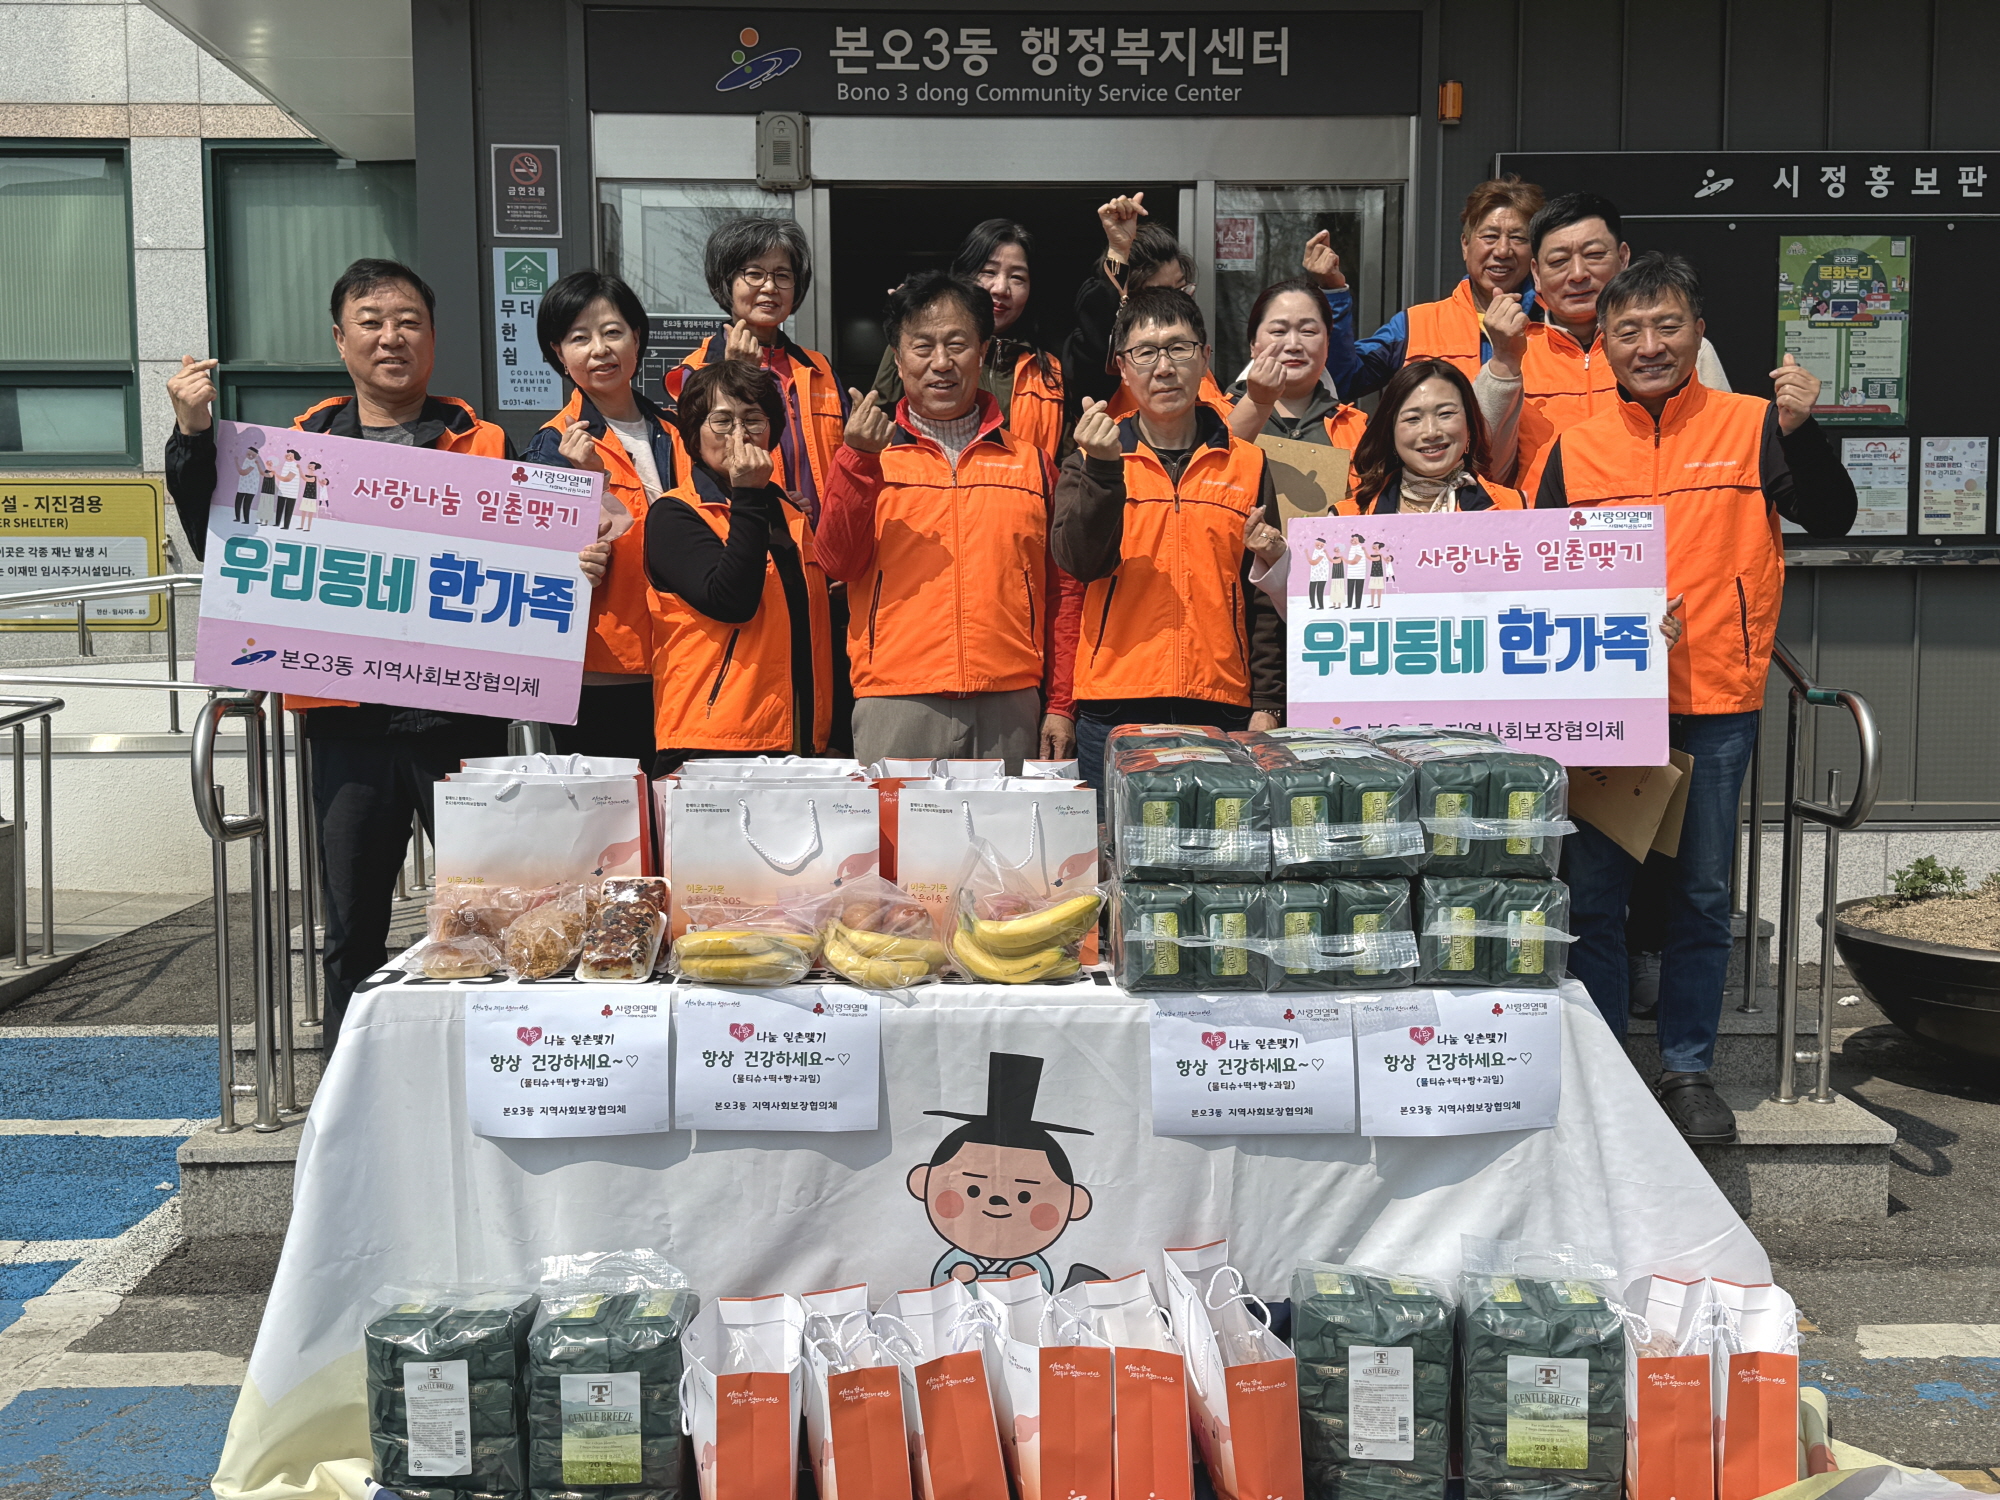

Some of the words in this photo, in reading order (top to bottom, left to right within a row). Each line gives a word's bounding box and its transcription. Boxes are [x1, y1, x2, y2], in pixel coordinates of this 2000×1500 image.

[829, 26, 998, 77] 본오3동
[1020, 27, 1289, 77] 행정복지센터
[837, 83, 890, 101] Bono
[896, 83, 908, 101] 3
[916, 82, 969, 106] dong
[975, 83, 1093, 106] Community
[1098, 84, 1168, 102] Service
[1174, 84, 1242, 102] Center
[1773, 164, 1988, 199] 시정홍보판
[1834, 256, 1858, 264] 2025
[1819, 265, 1872, 279] 문화누리
[1832, 280, 1860, 294] 카드
[500, 300, 535, 318] 무더
[531, 469, 592, 487] 사랑의열매
[34, 495, 103, 513] 지진겸용
[353, 478, 462, 516] 사랑나눔
[476, 490, 579, 530] 일촌맺기
[13, 517, 69, 530] SHELTER)
[1589, 511, 1652, 524] 사랑의열매
[28, 547, 48, 558] 각종
[51, 547, 71, 558] 재난
[74, 547, 95, 558] 발생
[98, 547, 108, 558] 시
[1417, 541, 1522, 574] 사랑나눔
[1537, 538, 1643, 572] 일촌맺기
[7, 565, 38, 577] 이재민
[41, 565, 136, 577] 임시주거시설입니다.
[220, 536, 418, 614] 우리동네
[428, 551, 577, 634] 한가족
[1302, 618, 1486, 676] 우리동네
[1498, 606, 1650, 676] 한가족
[280, 649, 354, 676] 본오3동
[362, 659, 541, 698] 지역사회보장협의체
[722, 896, 741, 905] SOS
[520, 1029, 539, 1042] 사랑
[544, 1034, 566, 1046] 나눔
[571, 1033, 615, 1046] 일촌맺기
[732, 1026, 751, 1038] 사랑
[756, 1031, 779, 1043] 나눔
[783, 1031, 827, 1043] 일촌맺기
[1205, 1034, 1223, 1047] 사랑
[1229, 1038, 1251, 1050] 나눔
[1255, 1037, 1299, 1050] 일촌맺기
[1413, 1029, 1432, 1042] 사랑
[1437, 1034, 1459, 1045] 나눔
[1464, 1032, 1507, 1044] 일촌맺기
[490, 1054, 522, 1073] 항상
[702, 1050, 735, 1068] 항상
[1384, 1054, 1416, 1072] 항상
[1176, 1059, 1208, 1076] 항상
[502, 1106, 535, 1117] 본오3동
[539, 1104, 627, 1116] 지역사회보장협의체
[714, 1101, 747, 1111] 본오3동
[752, 1100, 838, 1111] 지역사회보장협의체
[1191, 1108, 1223, 1118] 본오3동
[1228, 1106, 1314, 1117] 지역사회보장협의체
[1400, 1105, 1433, 1116] 본오3동
[1437, 1100, 1521, 1115] 지역사회보장협의체
[1362, 1367, 1381, 1375] GENTLE
[1382, 1367, 1400, 1376] BREEZE
[1539, 1368, 1557, 1384] T
[417, 1382, 436, 1391] GENTLE
[436, 1382, 455, 1390] BREEZE
[592, 1385, 608, 1402] T
[1514, 1392, 1546, 1405] GENTLE
[1548, 1394, 1582, 1407] BREEZE
[568, 1411, 600, 1423] GENTLE
[601, 1411, 634, 1422] BREEZE
